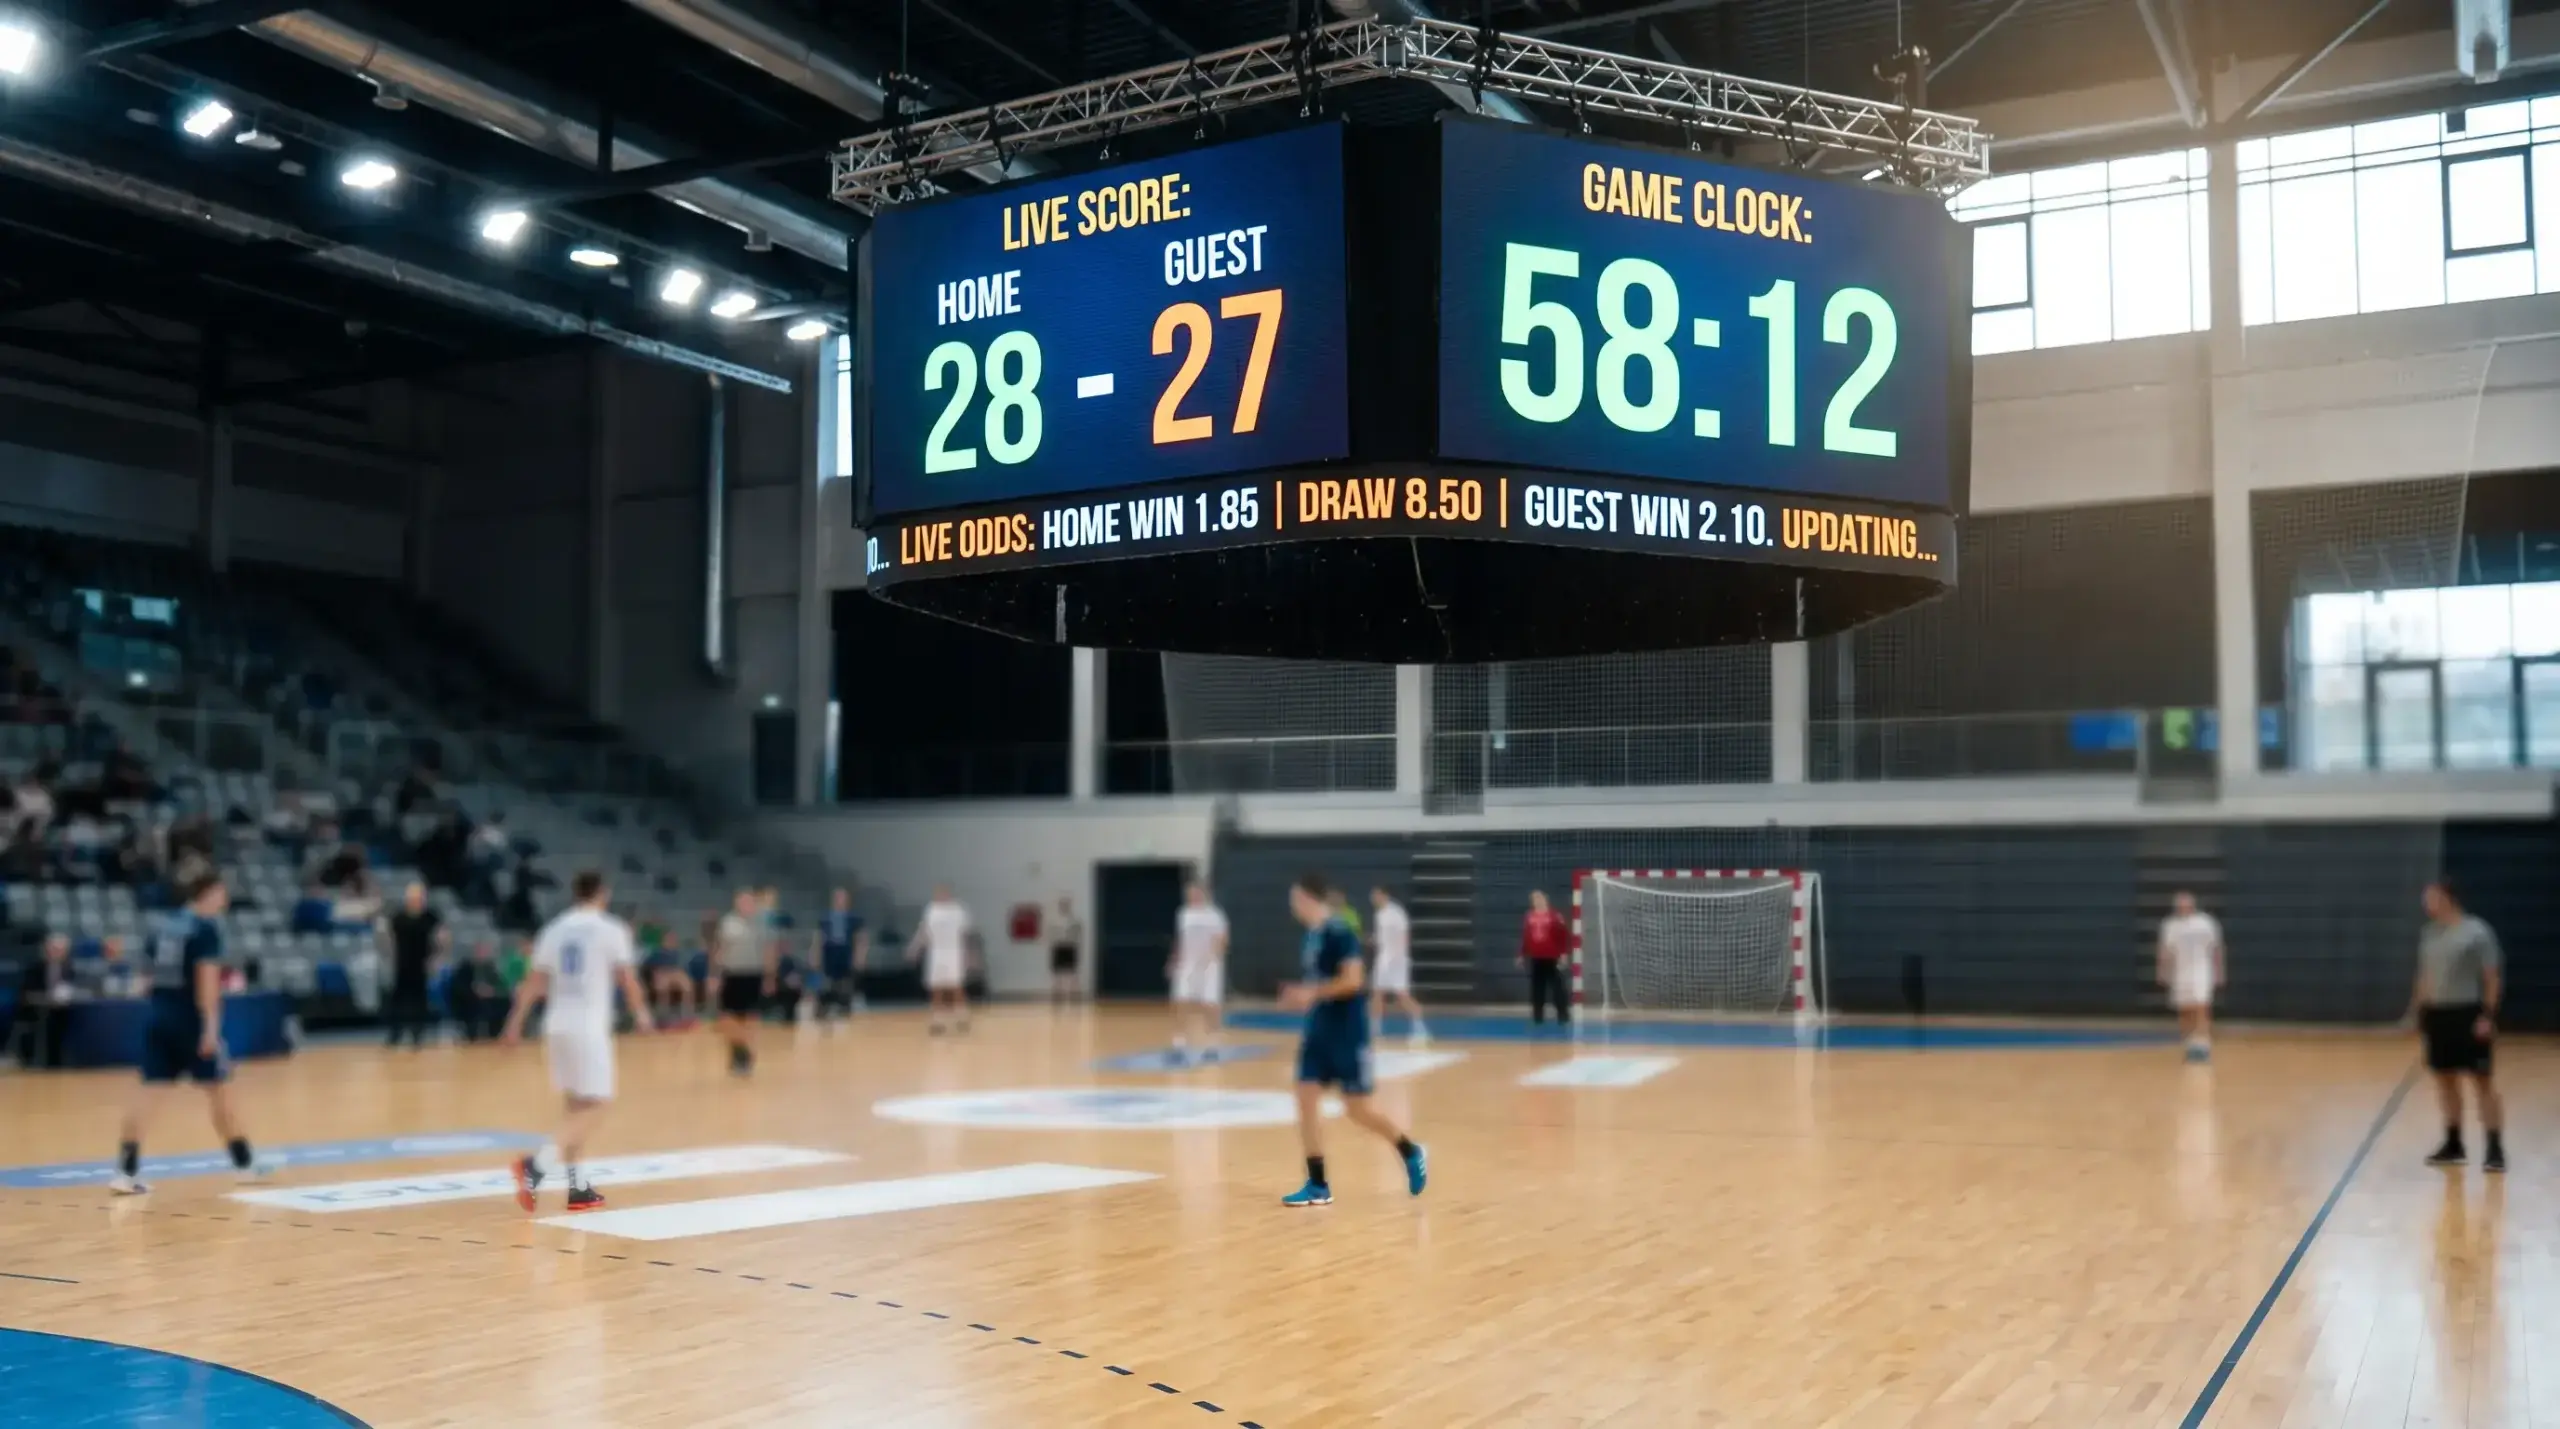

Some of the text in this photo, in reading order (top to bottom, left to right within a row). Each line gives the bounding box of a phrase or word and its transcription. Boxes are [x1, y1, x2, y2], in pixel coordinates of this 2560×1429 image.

[1003, 173, 1191, 250] LIVE SCORE:
[1583, 163, 1812, 243] GAME CLOCK:
[1164, 225, 1267, 286] GUEST
[938, 269, 1021, 326] HOME
[924, 330, 1043, 474] 28
[1151, 289, 1283, 445] 27
[1500, 242, 1897, 457] 58:12
[901, 521, 952, 565] LIVE
[959, 513, 1034, 558] ODDS:
[1043, 503, 1120, 550] HOME
[1129, 496, 1184, 540] WIN
[1195, 487, 1259, 533] 1.85
[1299, 478, 1395, 523] DRAW
[1405, 478, 1482, 521] 8.50
[1525, 485, 1622, 533] GUEST
[1631, 494, 1690, 540] WIN
[1698, 501, 1774, 547] 2.10.
[1782, 508, 1938, 562] UPDATING...
